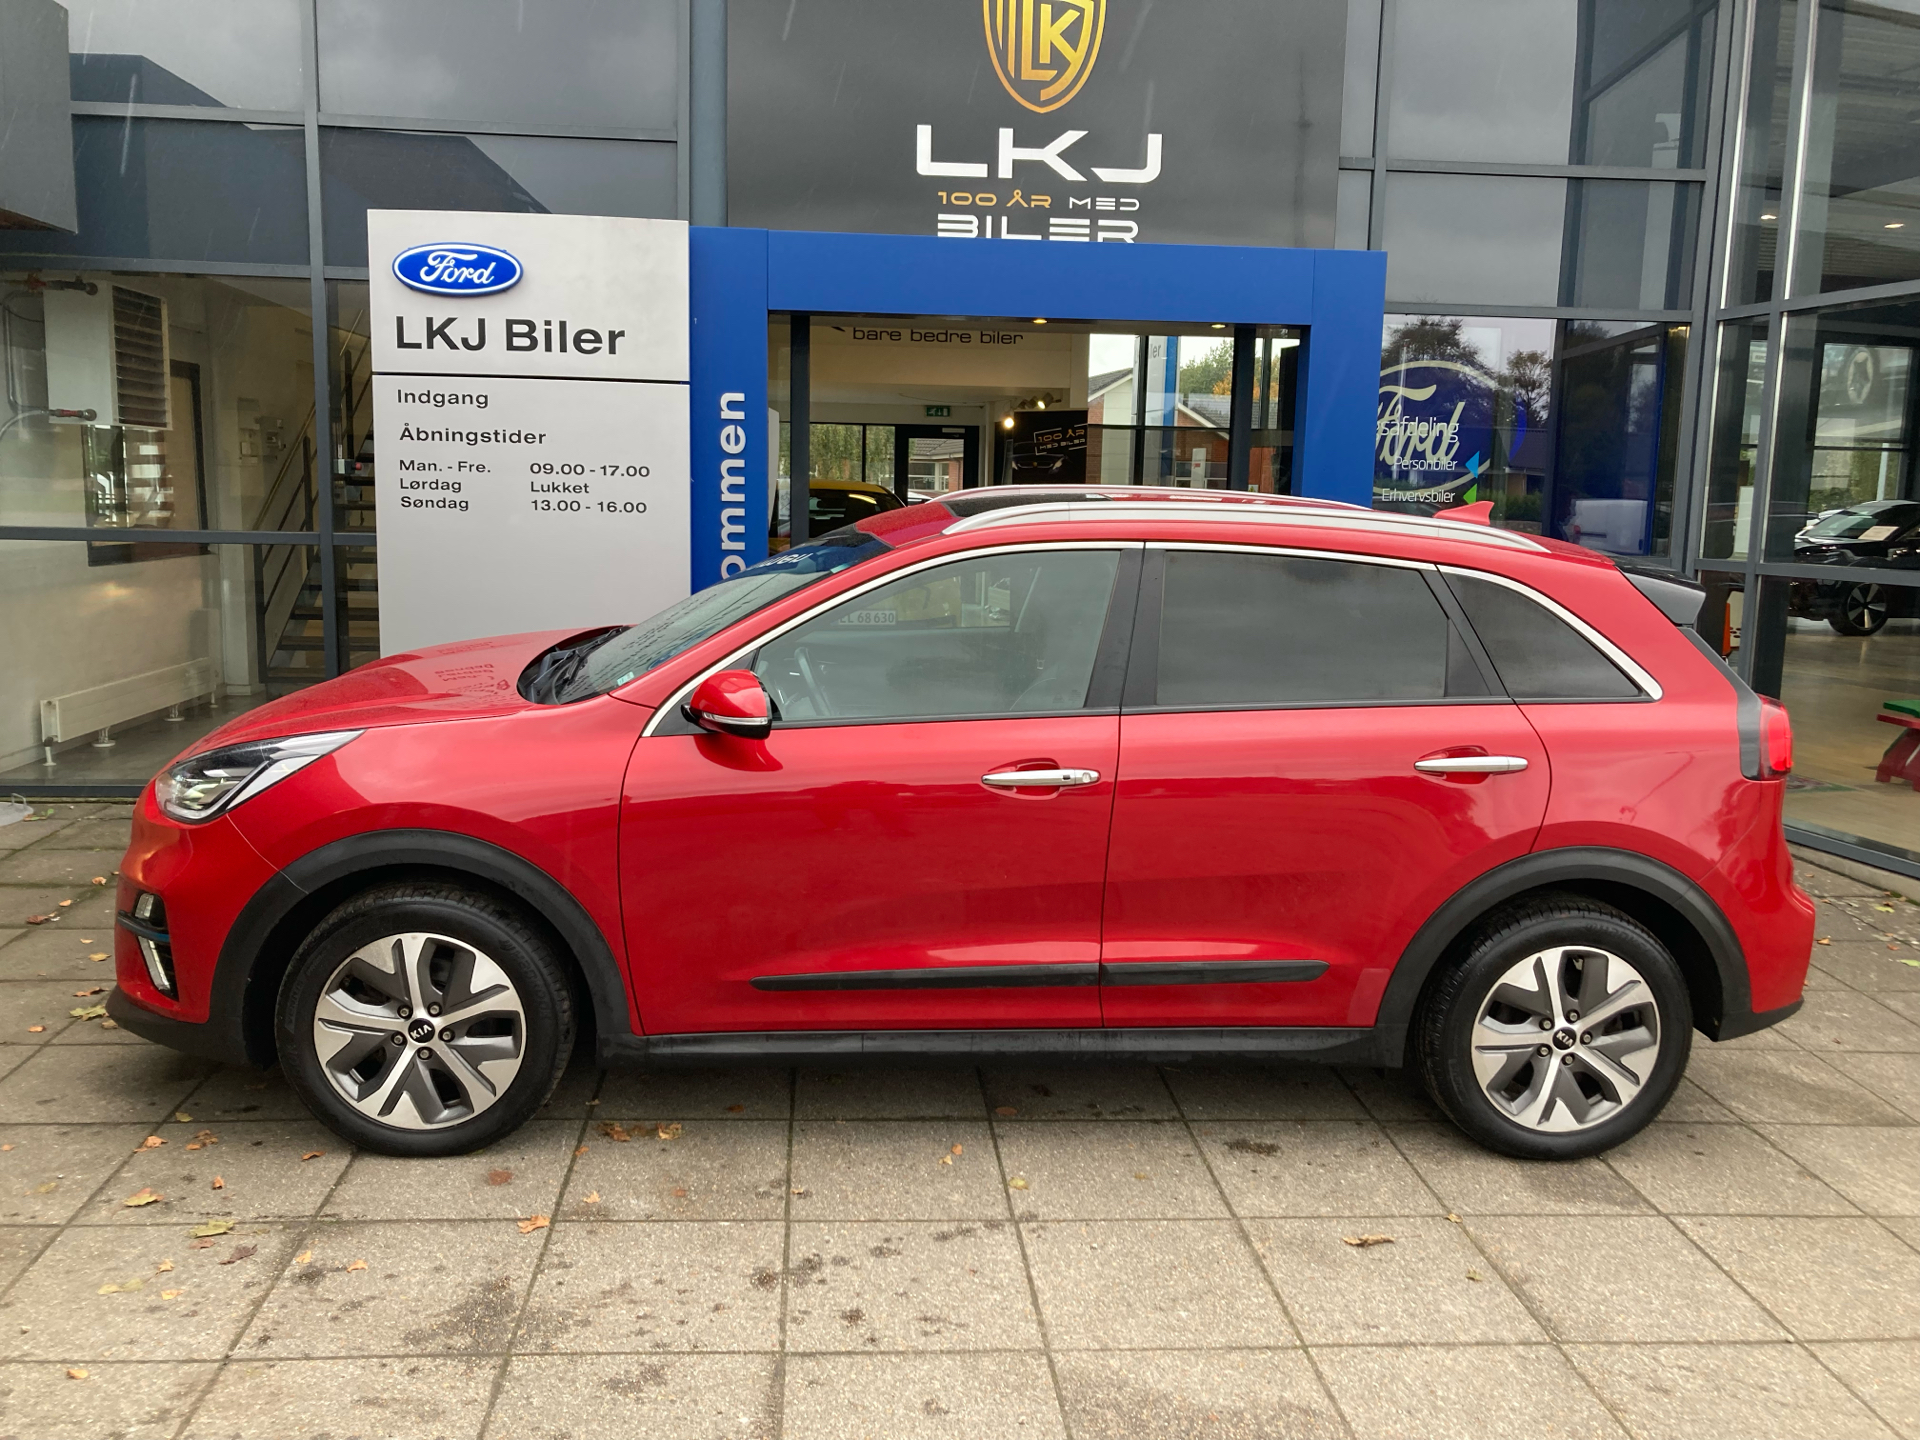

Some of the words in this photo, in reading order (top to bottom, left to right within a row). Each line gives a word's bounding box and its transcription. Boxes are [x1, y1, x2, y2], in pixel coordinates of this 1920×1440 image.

[916, 124, 1162, 183] LKJ
[938, 190, 997, 207] 100
[1006, 189, 1052, 208] ÅR
[1069, 196, 1140, 211] MED
[937, 213, 1139, 243] BILER
[419, 250, 497, 285] Ford
[395, 315, 487, 351] LKJ
[505, 318, 626, 355] Biler
[853, 327, 902, 341] bare
[910, 329, 972, 343] bedre
[980, 330, 1024, 345] biler
[397, 389, 489, 409] Indgang
[399, 422, 547, 446] Åbningstider
[1377, 416, 1460, 442] safdeling
[1038, 432, 1063, 443] 100
[399, 459, 443, 473] Man.
[457, 461, 491, 474] Fre.
[530, 463, 585, 476] 09.00
[600, 464, 651, 478] 17.00
[1394, 455, 1458, 471] Personbiler
[400, 478, 462, 493] Lørdag
[530, 481, 590, 494] Lukket
[1382, 488, 1456, 503] Erhvervsbiler
[400, 496, 469, 512] Søndag
[531, 499, 581, 512] 13.00
[597, 501, 648, 514] 16.00
[857, 612, 872, 623] 68
[873, 612, 895, 623] 630
[410, 1024, 433, 1040] KIA
[1555, 1030, 1575, 1046] KIA
